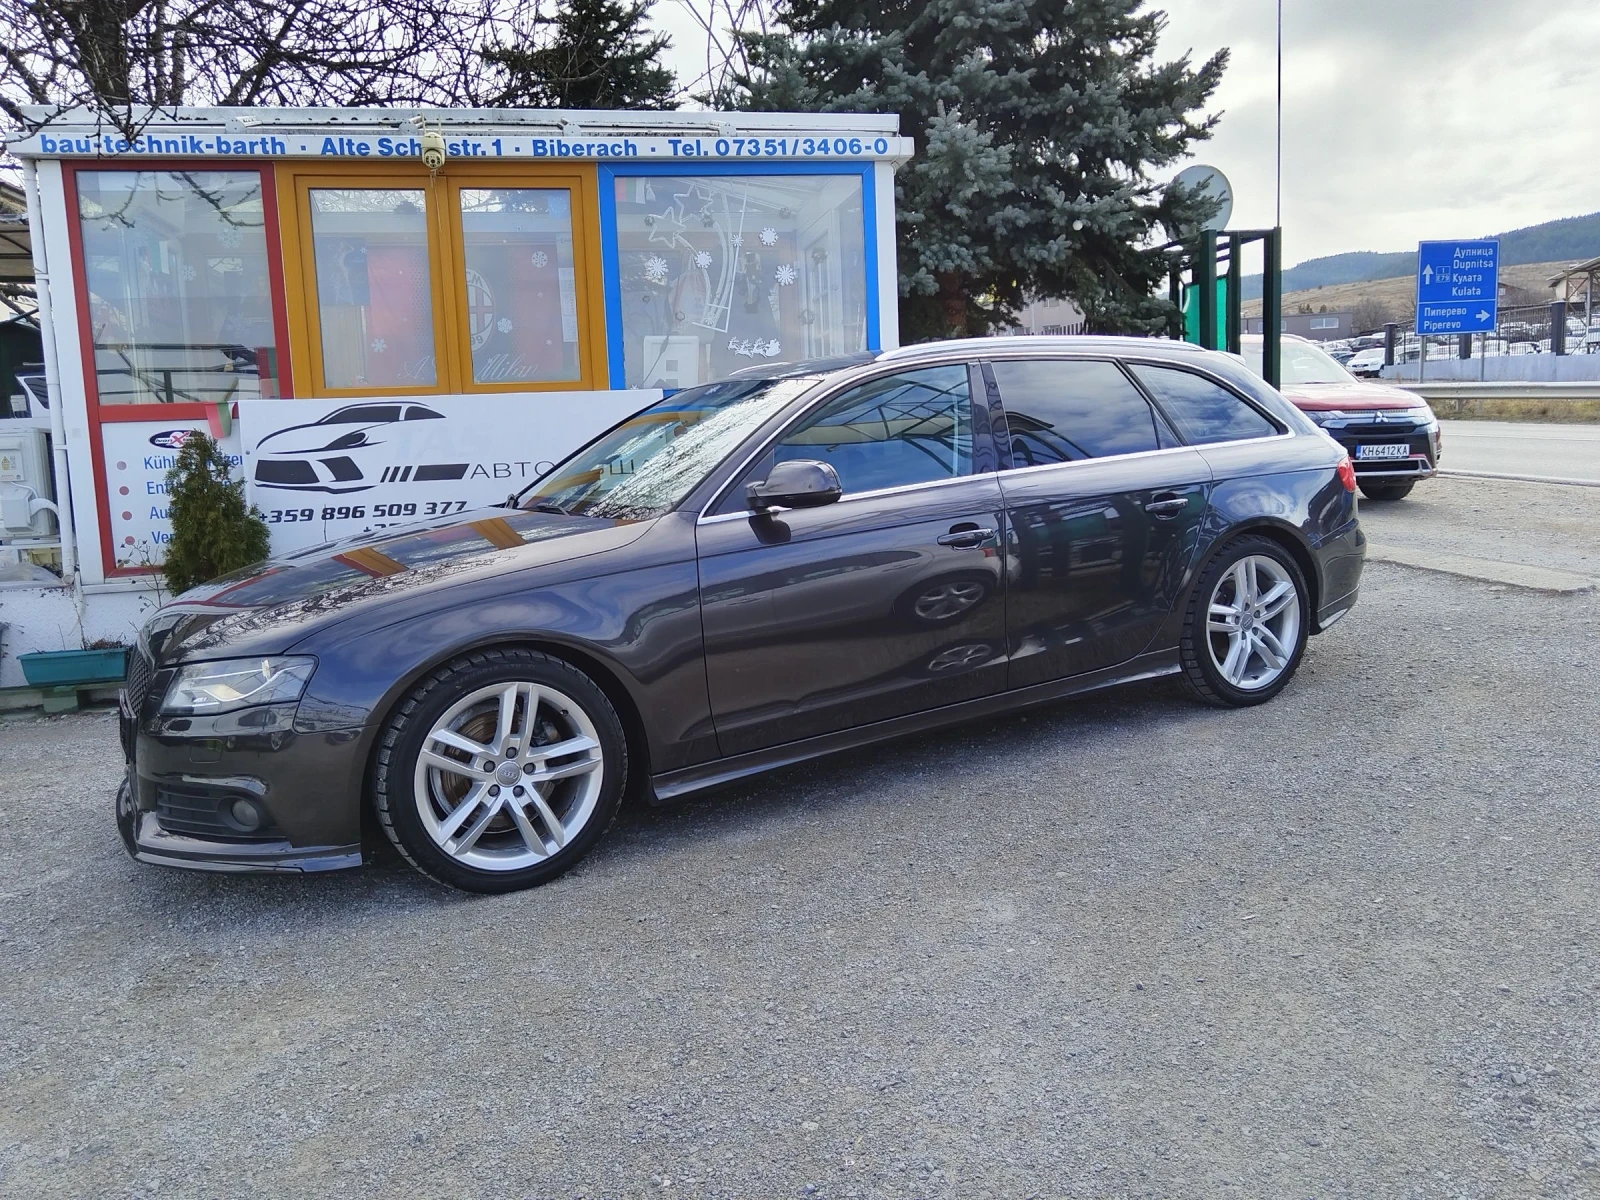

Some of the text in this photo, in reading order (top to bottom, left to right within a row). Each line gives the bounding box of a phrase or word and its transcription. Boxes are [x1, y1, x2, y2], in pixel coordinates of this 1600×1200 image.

[40, 134, 888, 157] bau-technik-barth Alte Schstr. 1 Biberach Tel. 07351/3406-0
[1453, 247, 1493, 259] Дупница
[1453, 259, 1494, 271] Dupnitsa
[1452, 273, 1482, 285] Кулата
[1452, 286, 1481, 296] Kulata
[1424, 307, 1467, 318] Пиперево
[1423, 320, 1462, 332] Piperevo
[1362, 446, 1407, 456] KH6412KA
[259, 500, 467, 523] +359 896 509 377
